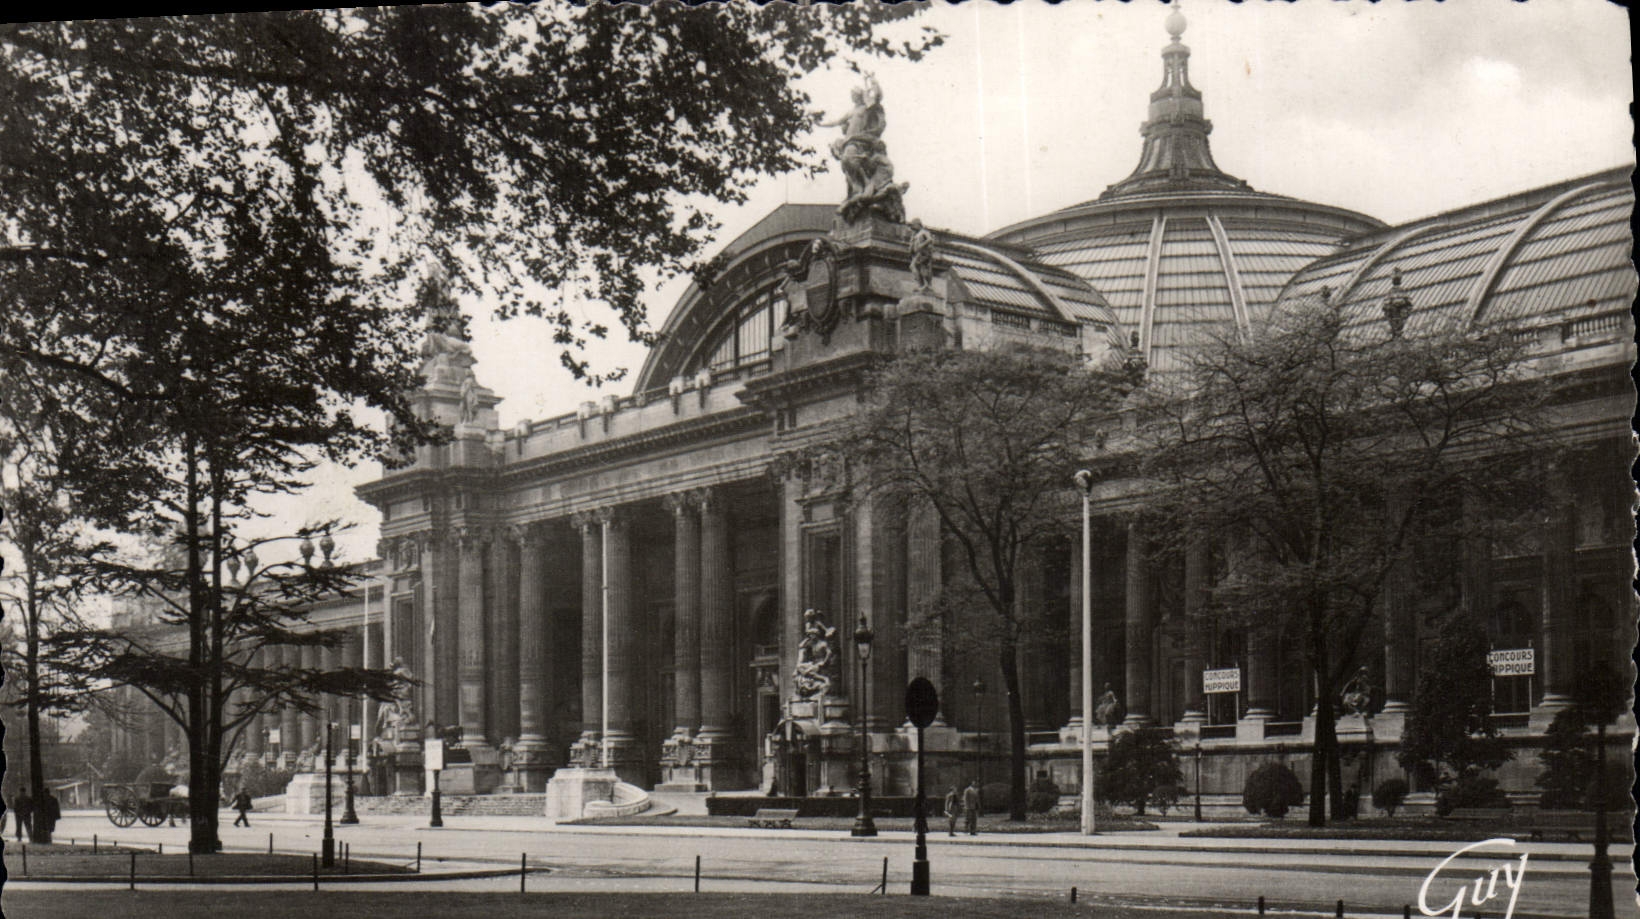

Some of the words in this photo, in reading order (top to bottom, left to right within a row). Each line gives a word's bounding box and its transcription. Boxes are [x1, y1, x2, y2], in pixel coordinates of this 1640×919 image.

[1489, 651, 1533, 662] CONCOURS
[1491, 663, 1533, 673] IPPIQUE
[1205, 671, 1238, 680] CONCOURS
[1205, 680, 1239, 690] HIPPIQUE
